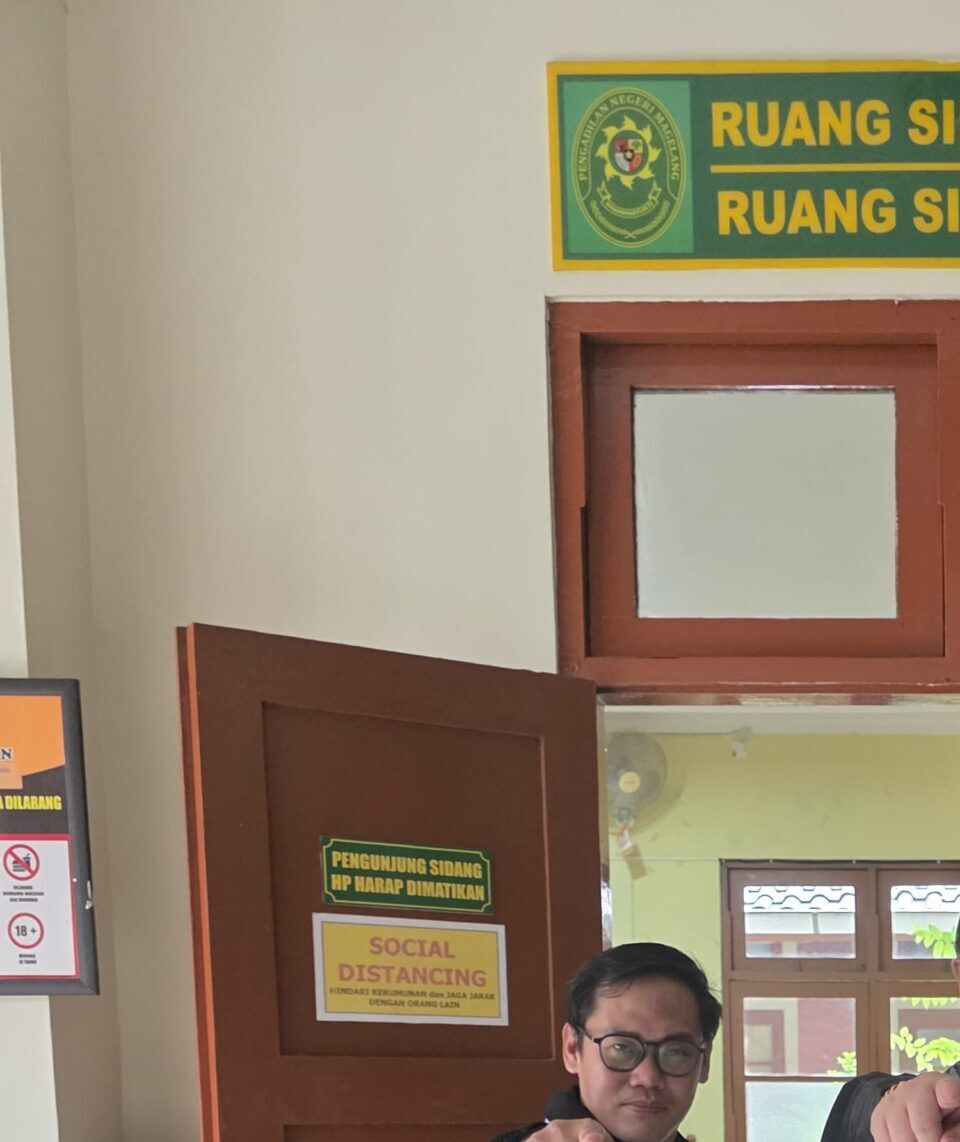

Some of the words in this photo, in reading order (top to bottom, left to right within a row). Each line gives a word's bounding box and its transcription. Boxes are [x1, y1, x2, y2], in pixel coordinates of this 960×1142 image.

[579, 104, 610, 180] PENGADILAN
[610, 94, 654, 113] NEGERI
[653, 113, 680, 181] MAGELANG
[710, 100, 892, 148] RUANG
[717, 189, 896, 236] RUANG
[5, 795, 62, 810] DILARANG
[332, 851, 426, 874] PENGUNJUNG
[430, 860, 482, 879] SIDANG
[331, 874, 352, 892] HP
[354, 876, 404, 896] HARAP
[407, 880, 484, 901] DIMATIKAN
[369, 936, 456, 959] SOCIAL
[338, 963, 486, 988] DISTANCING
[369, 998, 406, 1007] DENGAN
[408, 1000, 438, 1008] ORANG
[440, 1000, 460, 1008] LAIN
